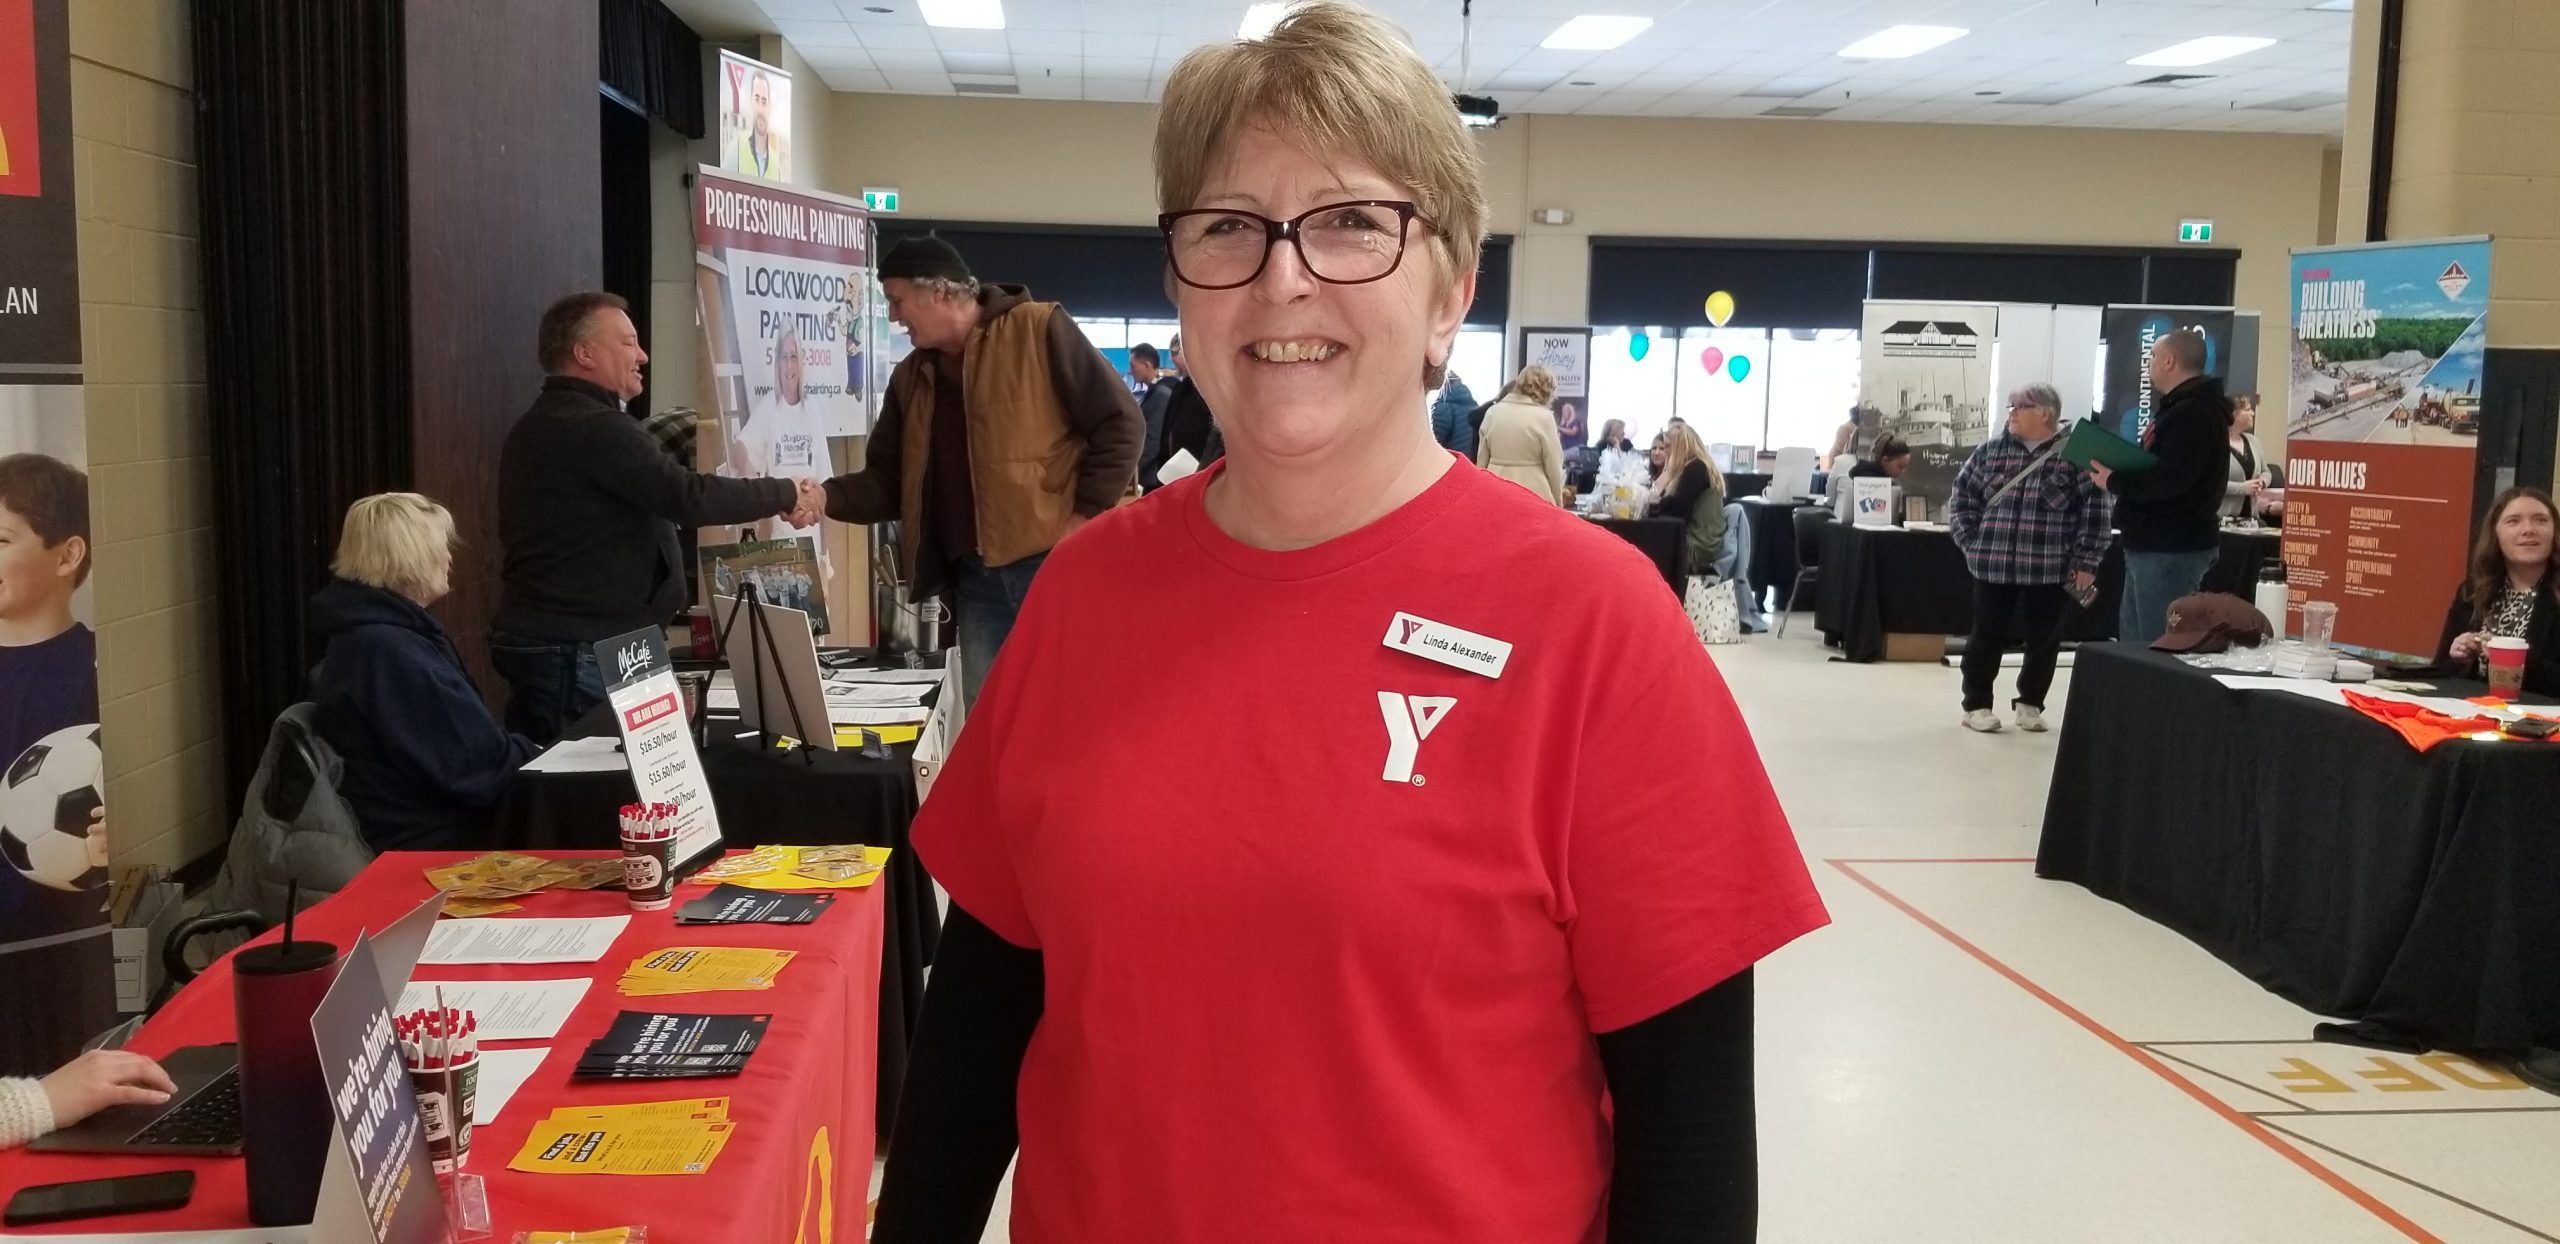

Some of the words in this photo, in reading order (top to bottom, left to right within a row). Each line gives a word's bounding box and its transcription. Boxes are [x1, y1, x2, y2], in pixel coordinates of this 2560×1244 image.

[705, 187, 807, 242] PROFESSIONAL
[810, 209, 865, 250] PAINTING
[0, 286, 38, 314] AN
[745, 266, 846, 304] LOCKWOOD
[2301, 279, 2366, 310] BUILDING
[760, 310, 836, 342] PATING
[2299, 309, 2376, 340] GREATNESS
[1544, 338, 1569, 348] NOW
[2288, 457, 2317, 487] OUR
[2319, 459, 2367, 490] VALUES
[2348, 535, 2379, 550] COMMUNITY
[617, 638, 653, 678] McCafé
[1423, 633, 1449, 650] Linda
[1450, 645, 1497, 664] Alexander
[639, 729, 678, 756] $16.50/hour
[639, 1014, 668, 1037] hiring
[661, 1017, 679, 1031] you
[630, 1037, 652, 1054] we're
[336, 1053, 370, 1122] we're
[361, 1005, 395, 1072] hiring
[350, 1109, 375, 1180] you
[367, 1079, 389, 1128] for
[383, 1049, 402, 1111] you
